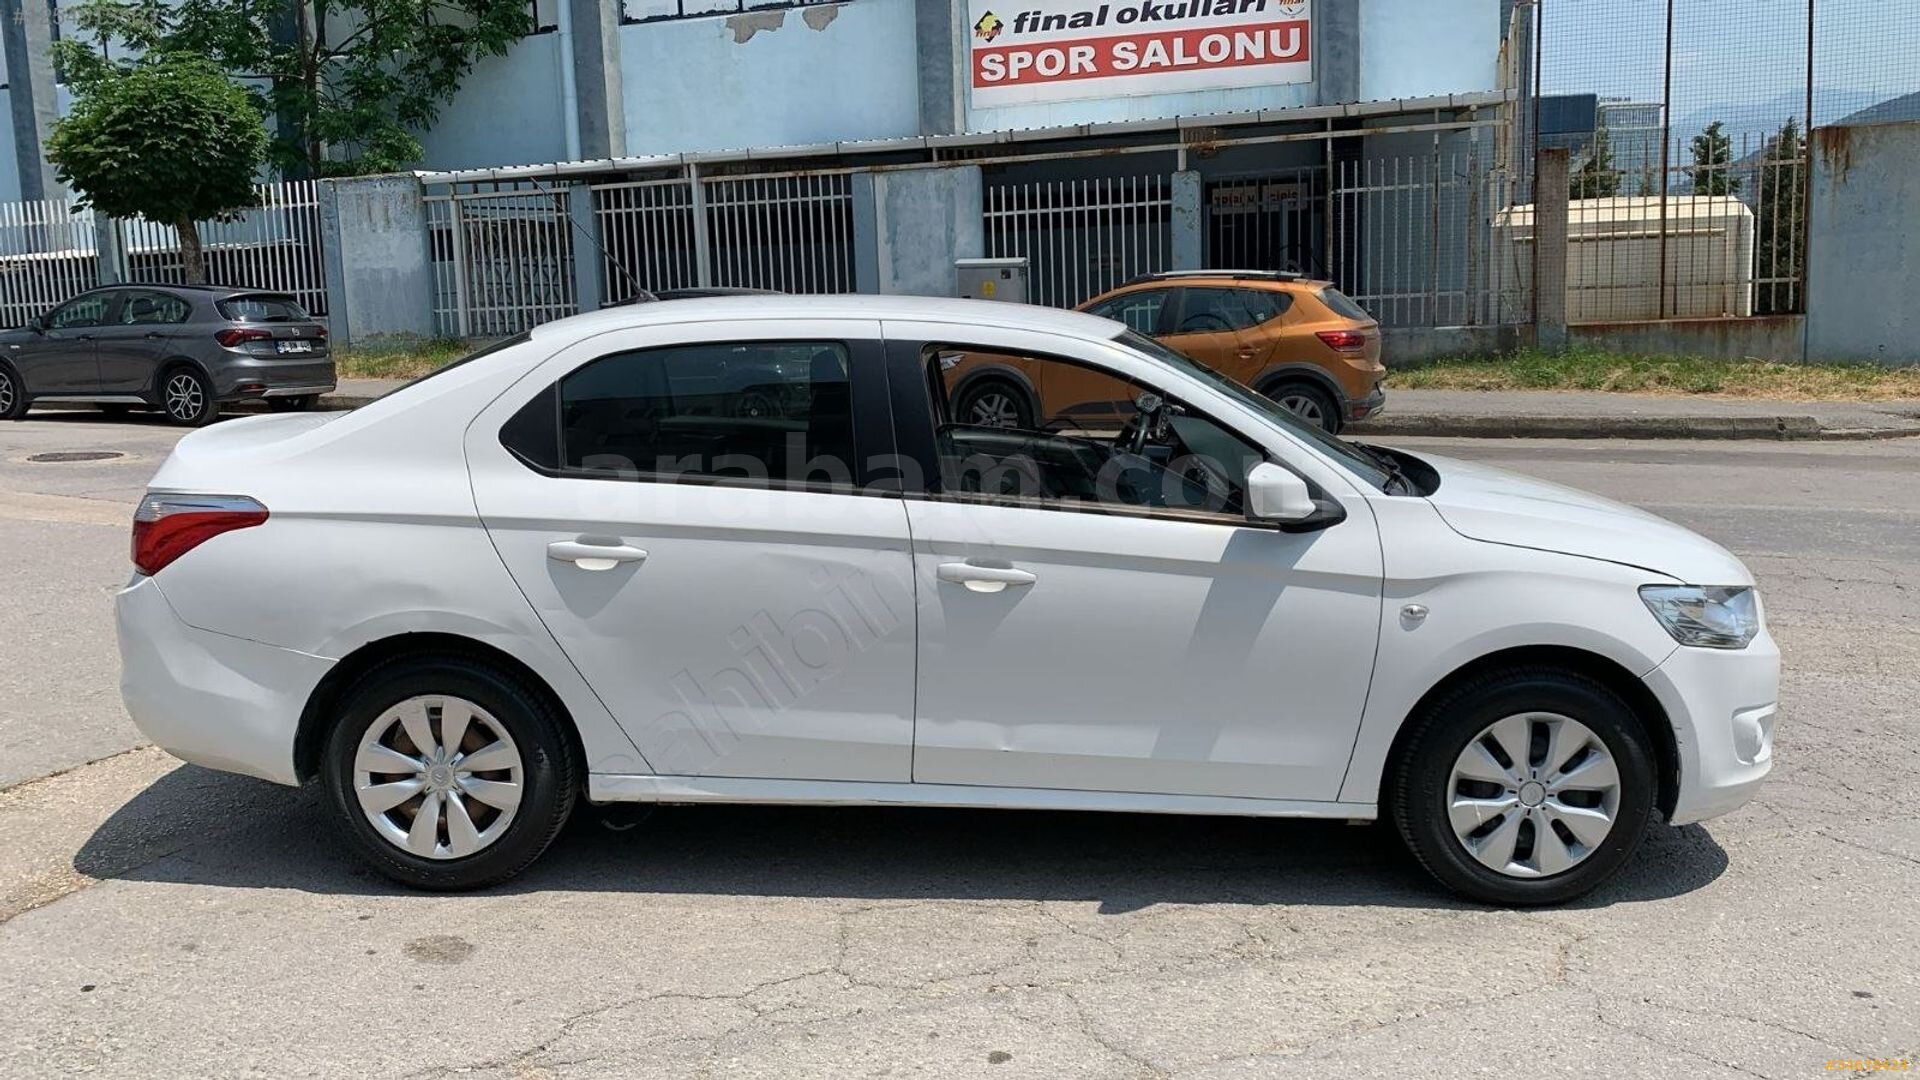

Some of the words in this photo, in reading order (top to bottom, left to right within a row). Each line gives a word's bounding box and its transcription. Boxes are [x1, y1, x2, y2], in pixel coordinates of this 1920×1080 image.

[1013, 5, 1110, 34] final
[980, 45, 1098, 82] SPOR
[1112, 28, 1301, 70] SALONU
